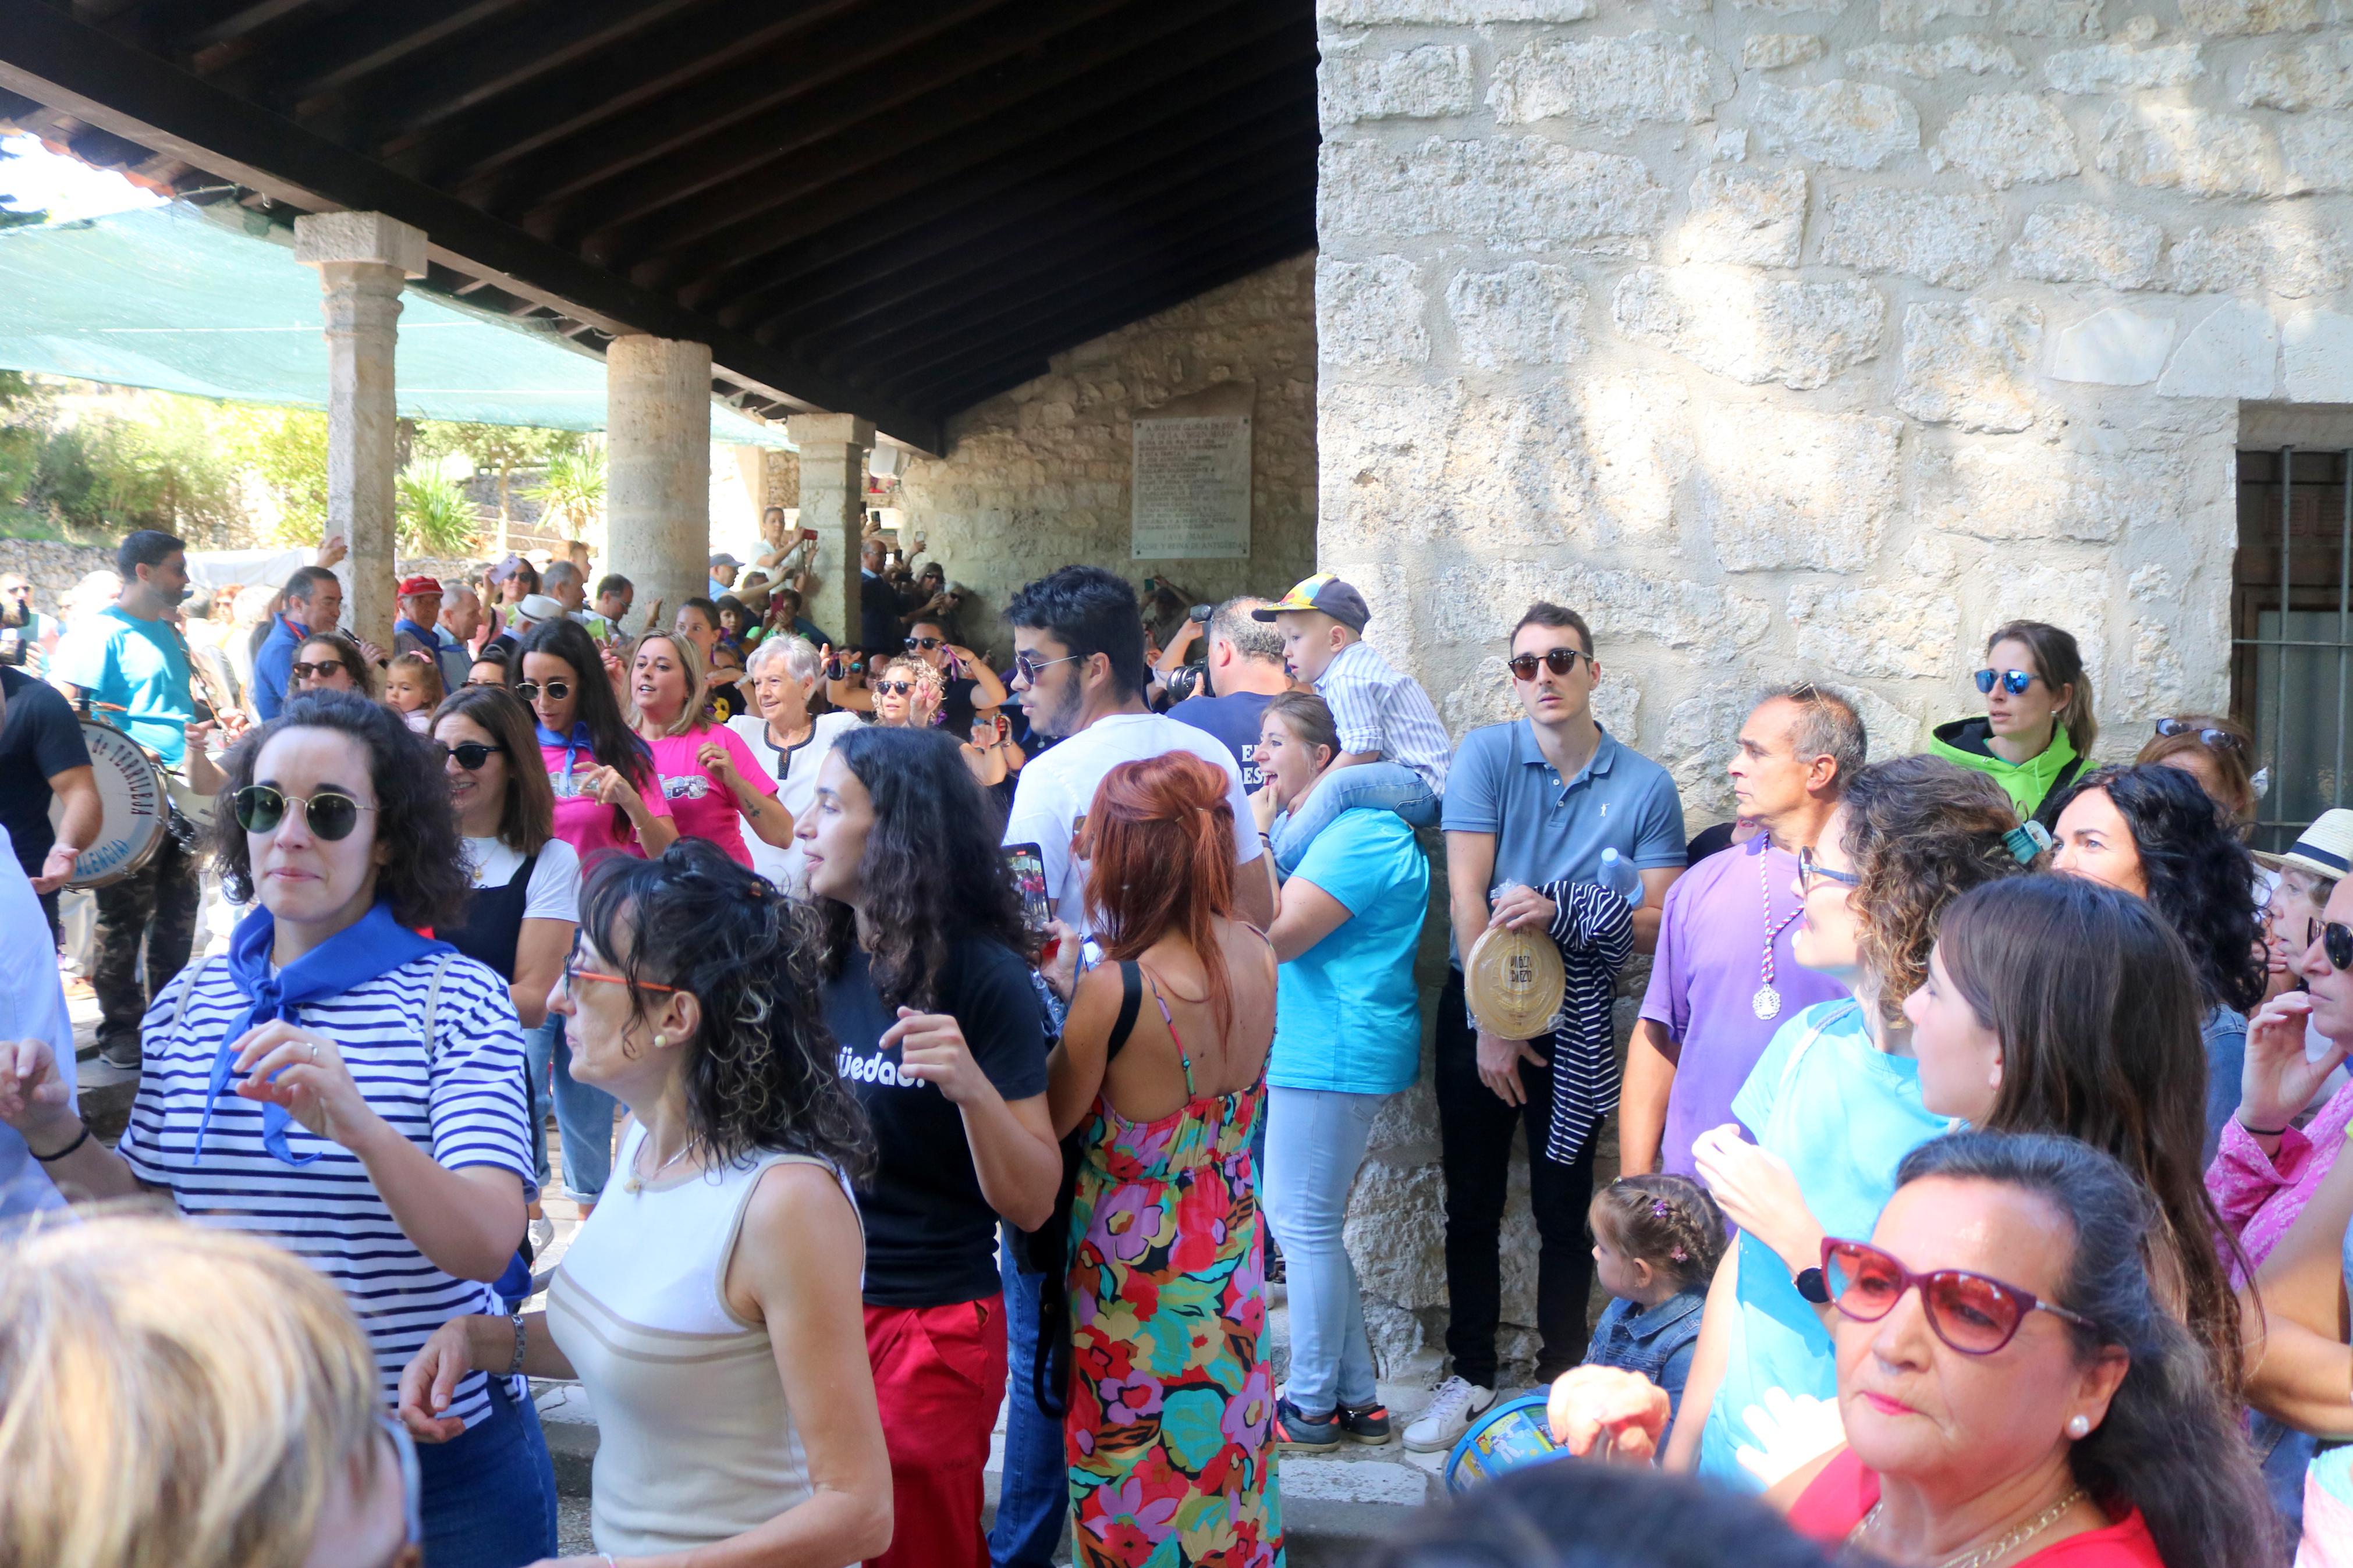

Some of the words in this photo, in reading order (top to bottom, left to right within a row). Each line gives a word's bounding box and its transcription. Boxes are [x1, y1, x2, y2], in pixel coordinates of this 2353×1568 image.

[1167, 542, 1189, 550] REINA
[1241, 744, 1258, 762] E
[92, 734, 108, 756] de
[109, 744, 154, 816] TERRILEJA
[1243, 767, 1266, 785] ES
[74, 839, 129, 876] ALENCIA)
[838, 1046, 925, 1089] üeda
